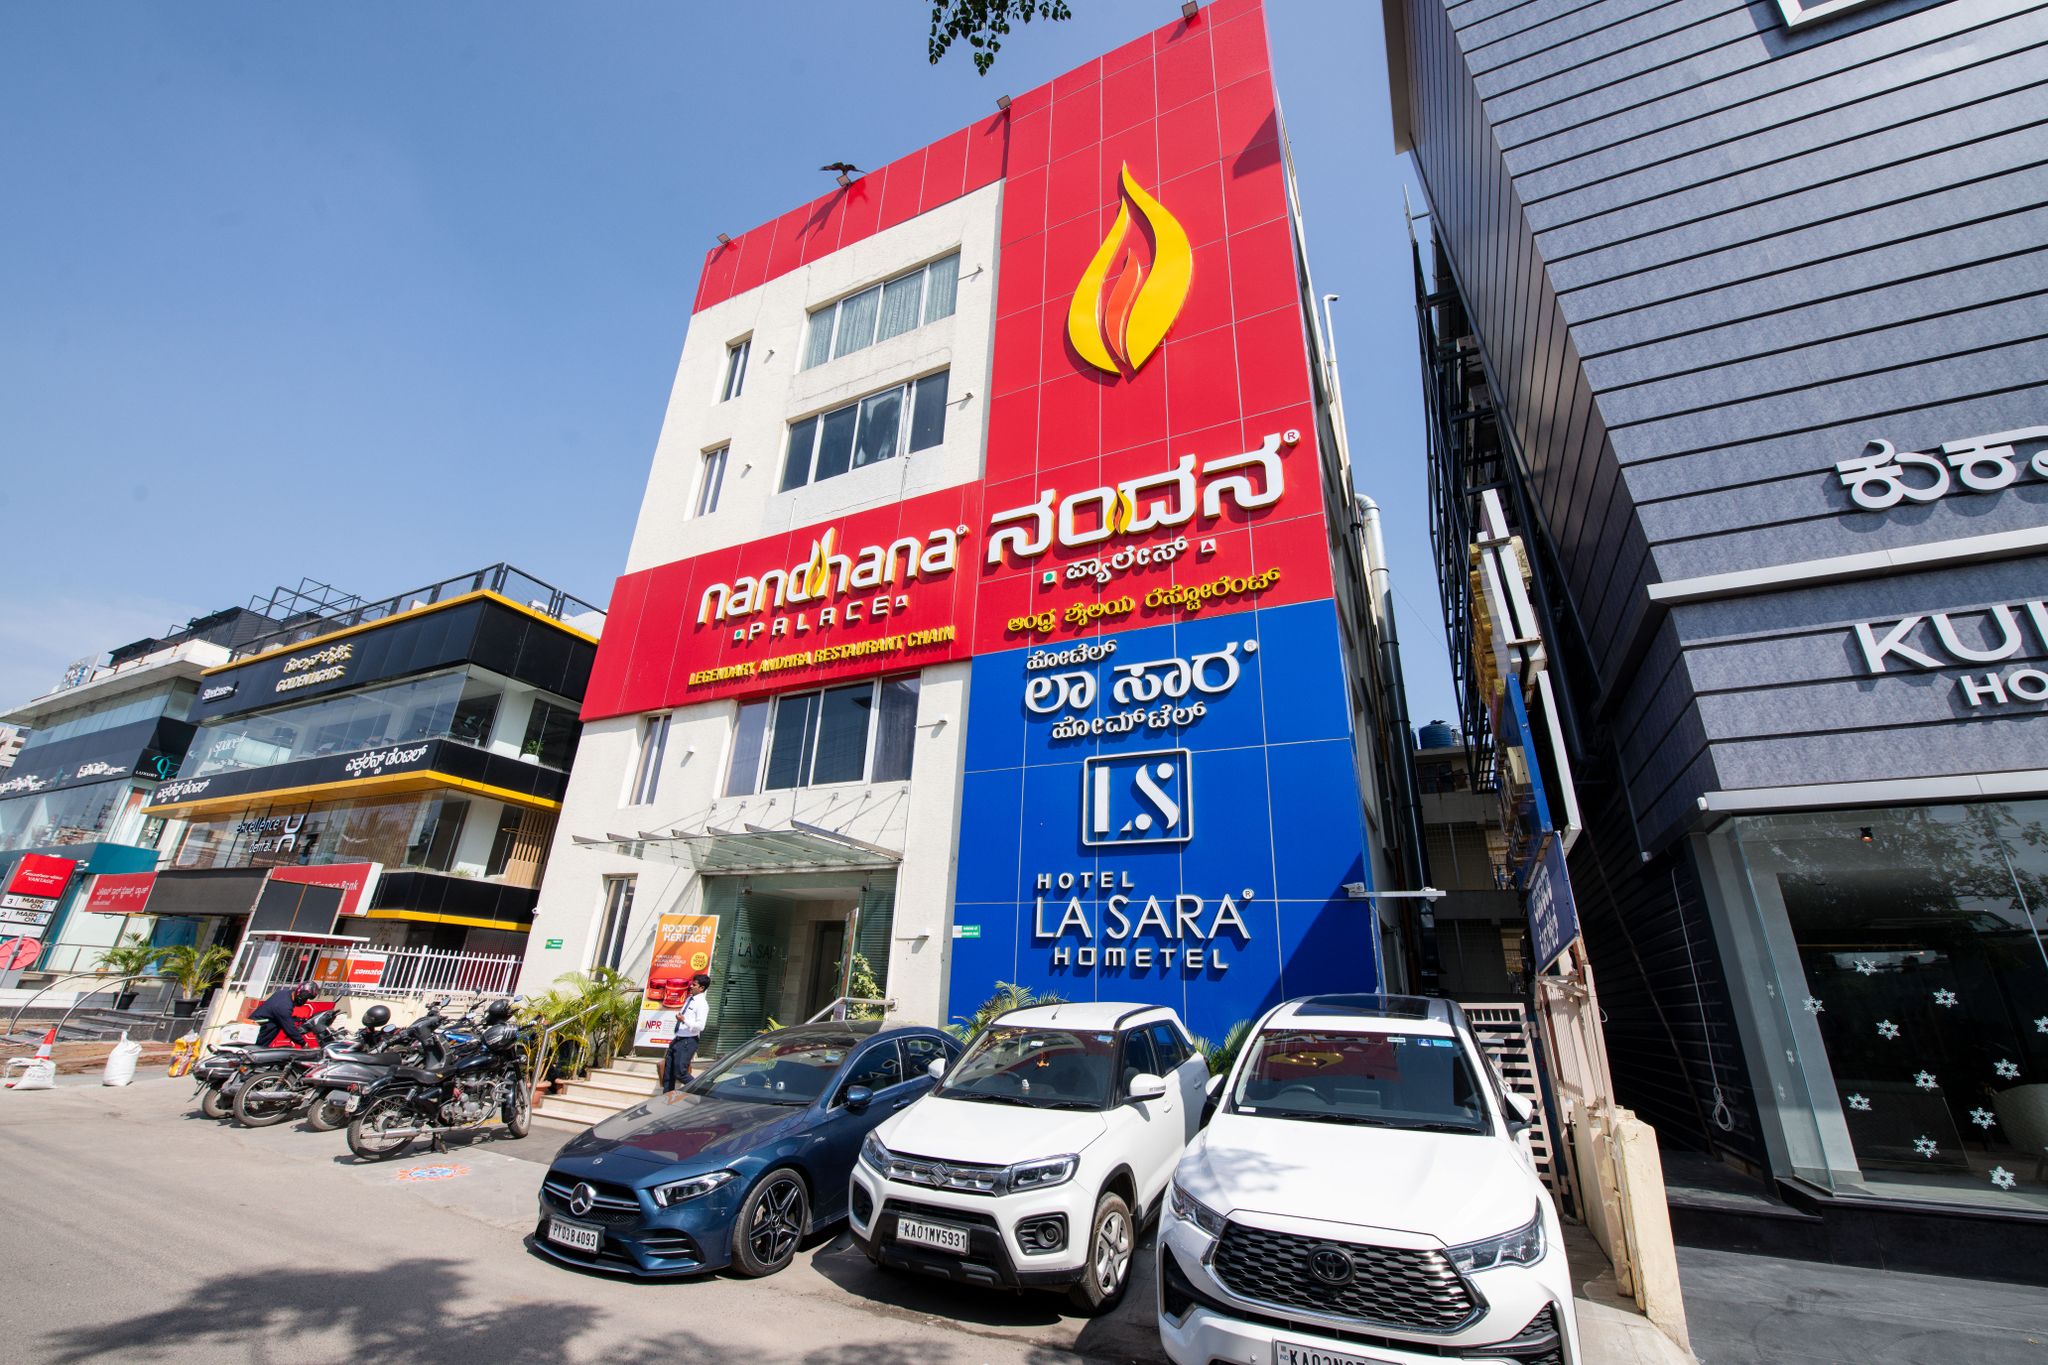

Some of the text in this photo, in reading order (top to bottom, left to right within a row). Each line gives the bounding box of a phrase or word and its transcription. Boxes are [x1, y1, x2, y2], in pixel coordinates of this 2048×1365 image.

[1066, 536, 1189, 583] ಪ್ಯಾಲೇಸ್
[1064, 595, 1136, 626] ಶೈಲಿಯ
[1145, 567, 1281, 611] ರೆಸ್ಟೋರೆಂಟ್
[748, 595, 890, 640] PALACE
[688, 625, 956, 686] LEGENDARY ANDHRA RESTAURANT CHAIN
[1027, 639, 1117, 669] ಹೋಟೆಲ್
[1024, 641, 1240, 714] ಲಾ ಸಾರ
[236, 816, 281, 833] excellence
[248, 839, 272, 853] dental
[1037, 870, 1135, 889] HOTEL
[1035, 893, 1251, 940] LA SARA
[661, 923, 712, 935] ROOTED IN
[663, 932, 707, 943] HERITAGE
[1054, 946, 1230, 969] HOMETEL
[354, 968, 383, 976] zomato
[645, 1020, 662, 1029] NPR
